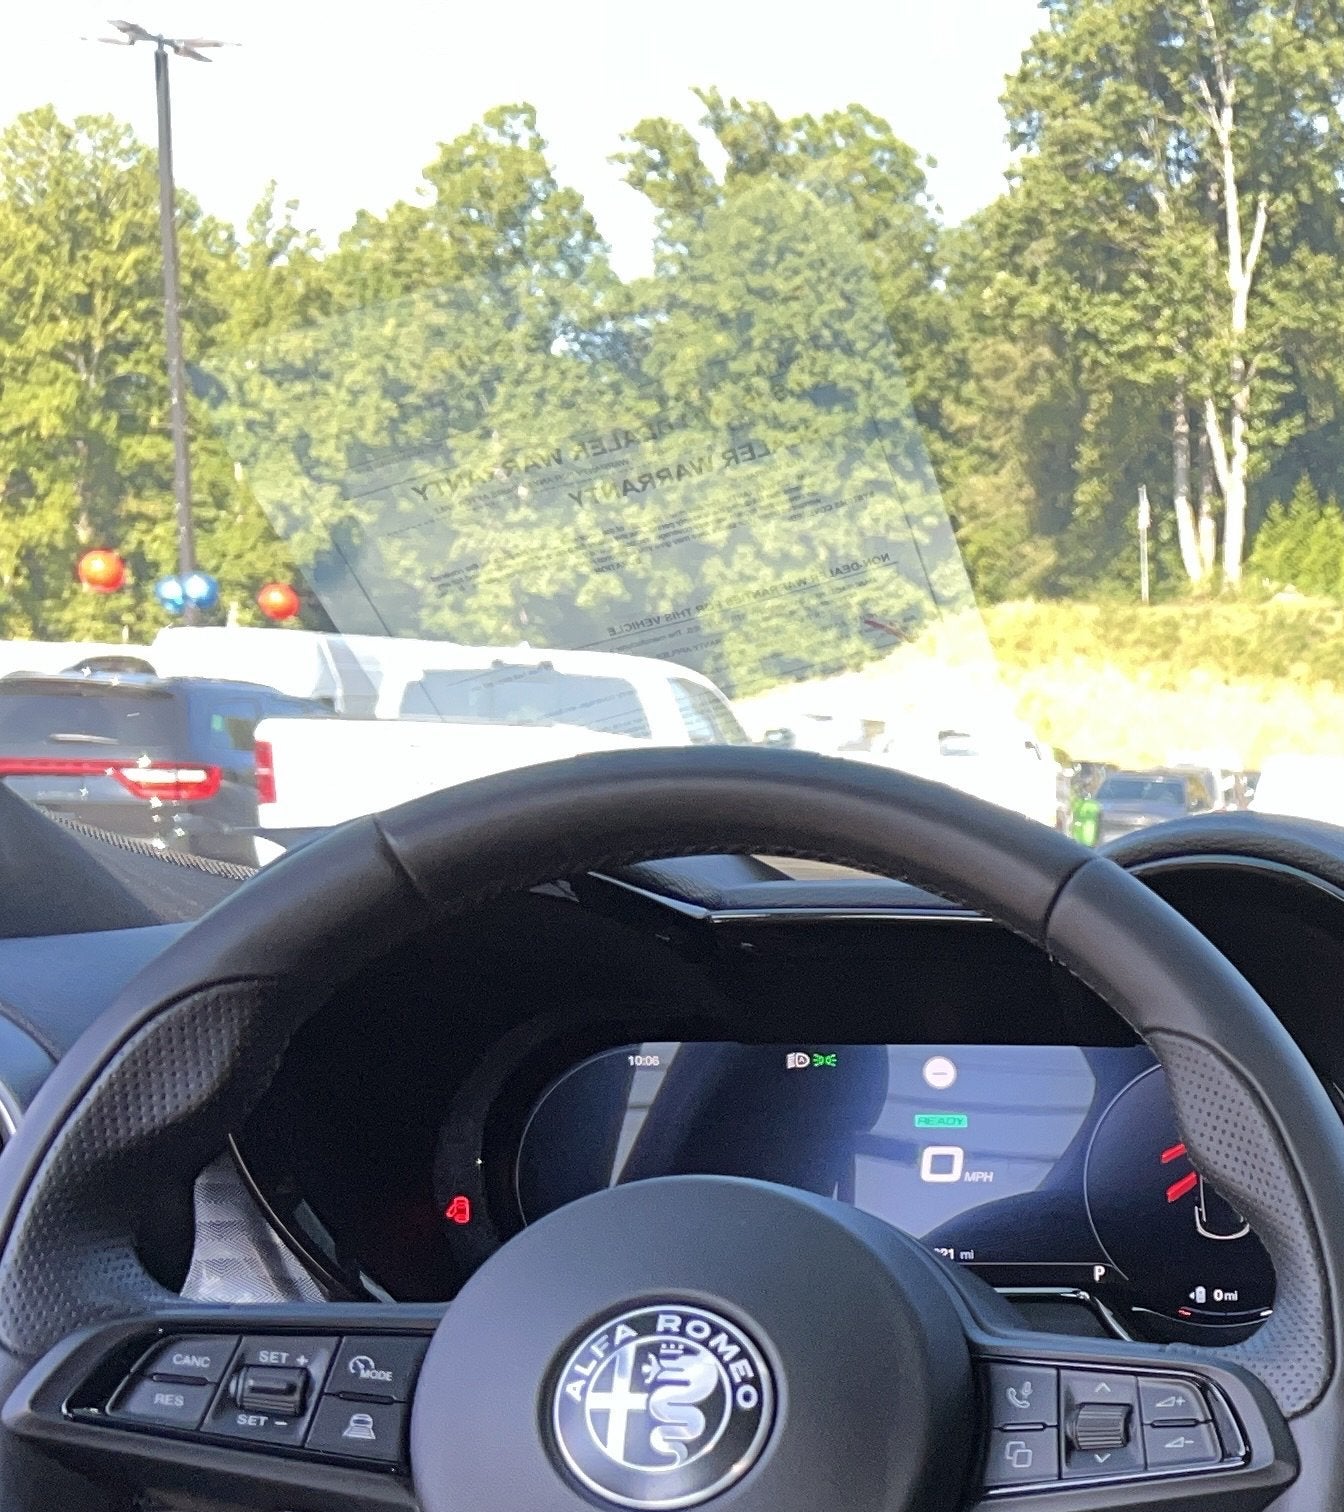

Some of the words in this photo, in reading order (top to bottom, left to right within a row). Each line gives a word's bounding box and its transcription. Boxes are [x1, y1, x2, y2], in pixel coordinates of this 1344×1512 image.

[627, 1055, 660, 1067] 10:06
[963, 1171, 995, 1183] MPH
[1093, 1265, 1106, 1282] P
[172, 1353, 211, 1369] CANC
[258, 1350, 289, 1365] SET
[564, 1323, 639, 1403] ALFA
[655, 1313, 759, 1410] ROMEO
[359, 1367, 393, 1382] MODE
[153, 1392, 185, 1407] RES
[236, 1413, 269, 1427] SET
